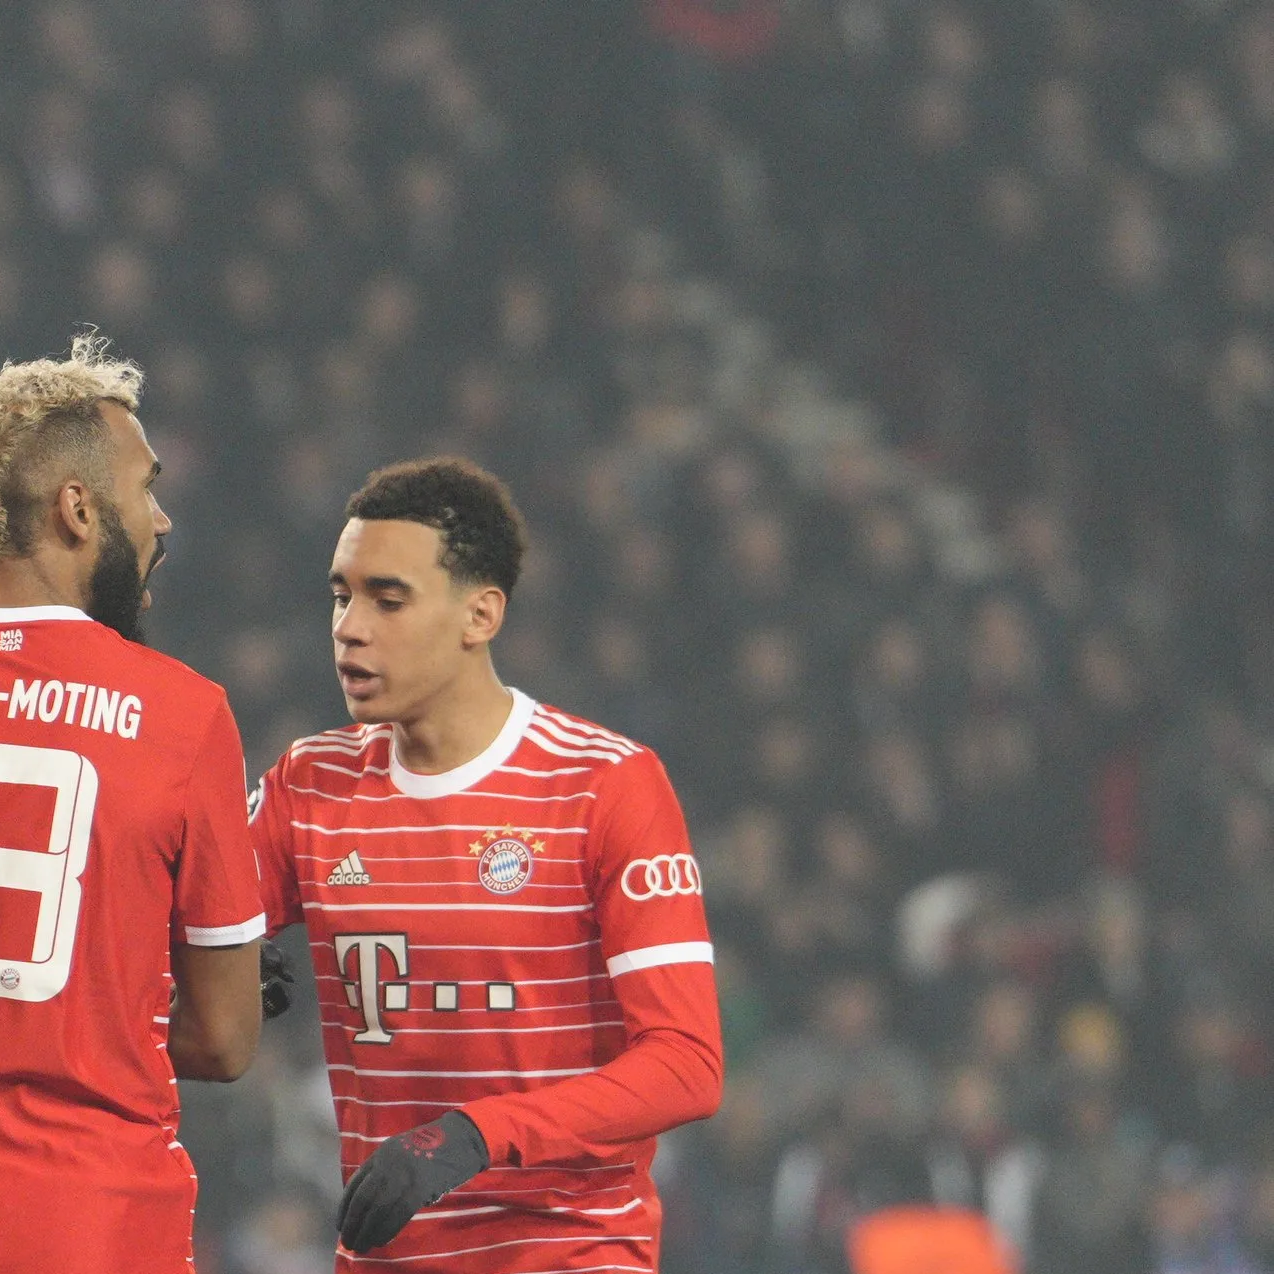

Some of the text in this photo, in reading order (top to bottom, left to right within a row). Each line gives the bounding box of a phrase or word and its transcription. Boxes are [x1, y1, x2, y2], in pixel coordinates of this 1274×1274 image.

[0, 629, 23, 640] MIA
[483, 842, 527, 864] FC BAYERN
[327, 871, 370, 885] adidas
